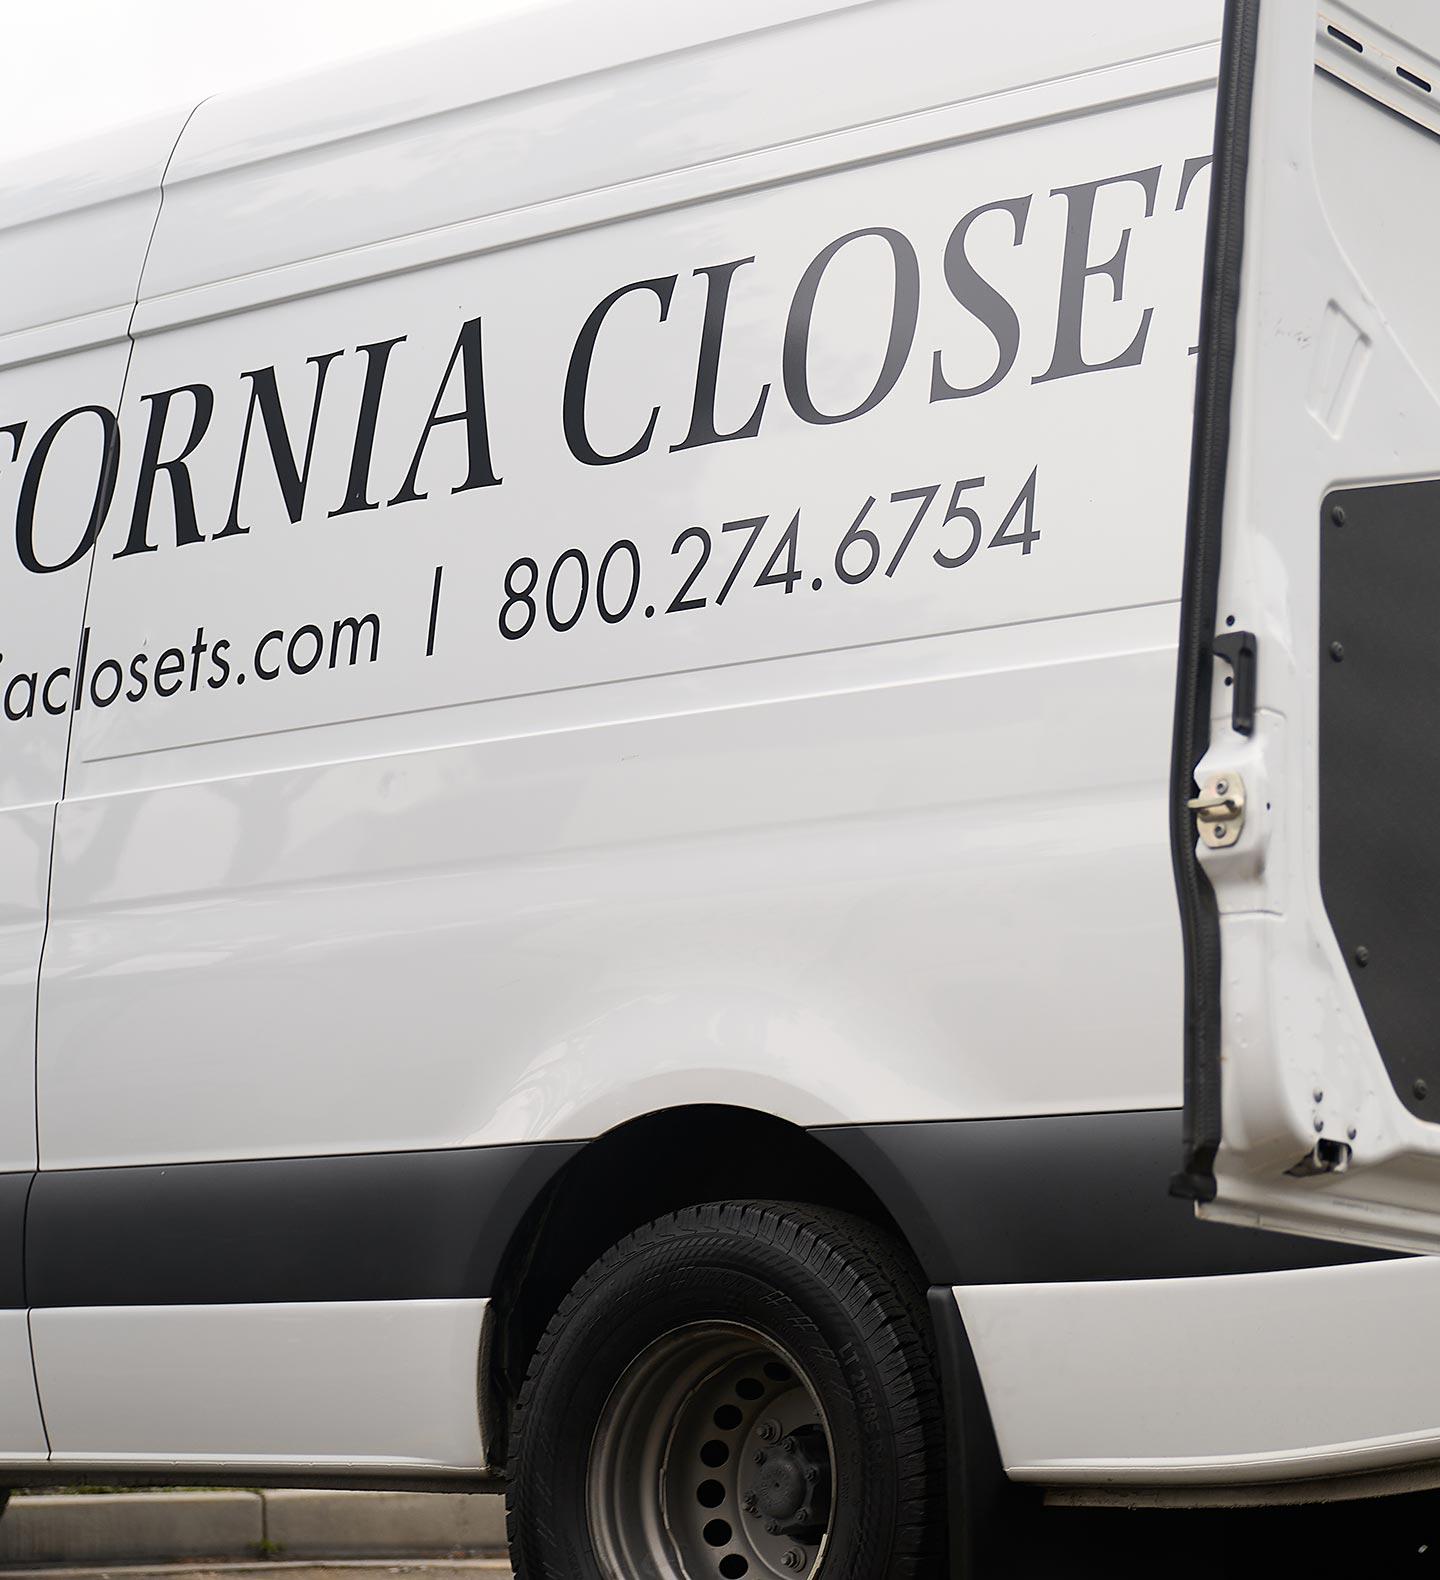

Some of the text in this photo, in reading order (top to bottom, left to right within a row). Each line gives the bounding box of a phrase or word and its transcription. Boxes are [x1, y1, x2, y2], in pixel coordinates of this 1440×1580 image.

[561, 153, 1214, 467] CLOSE
[0, 612, 380, 721] aclosets.com
[498, 465, 1041, 641] 800.274.6754
